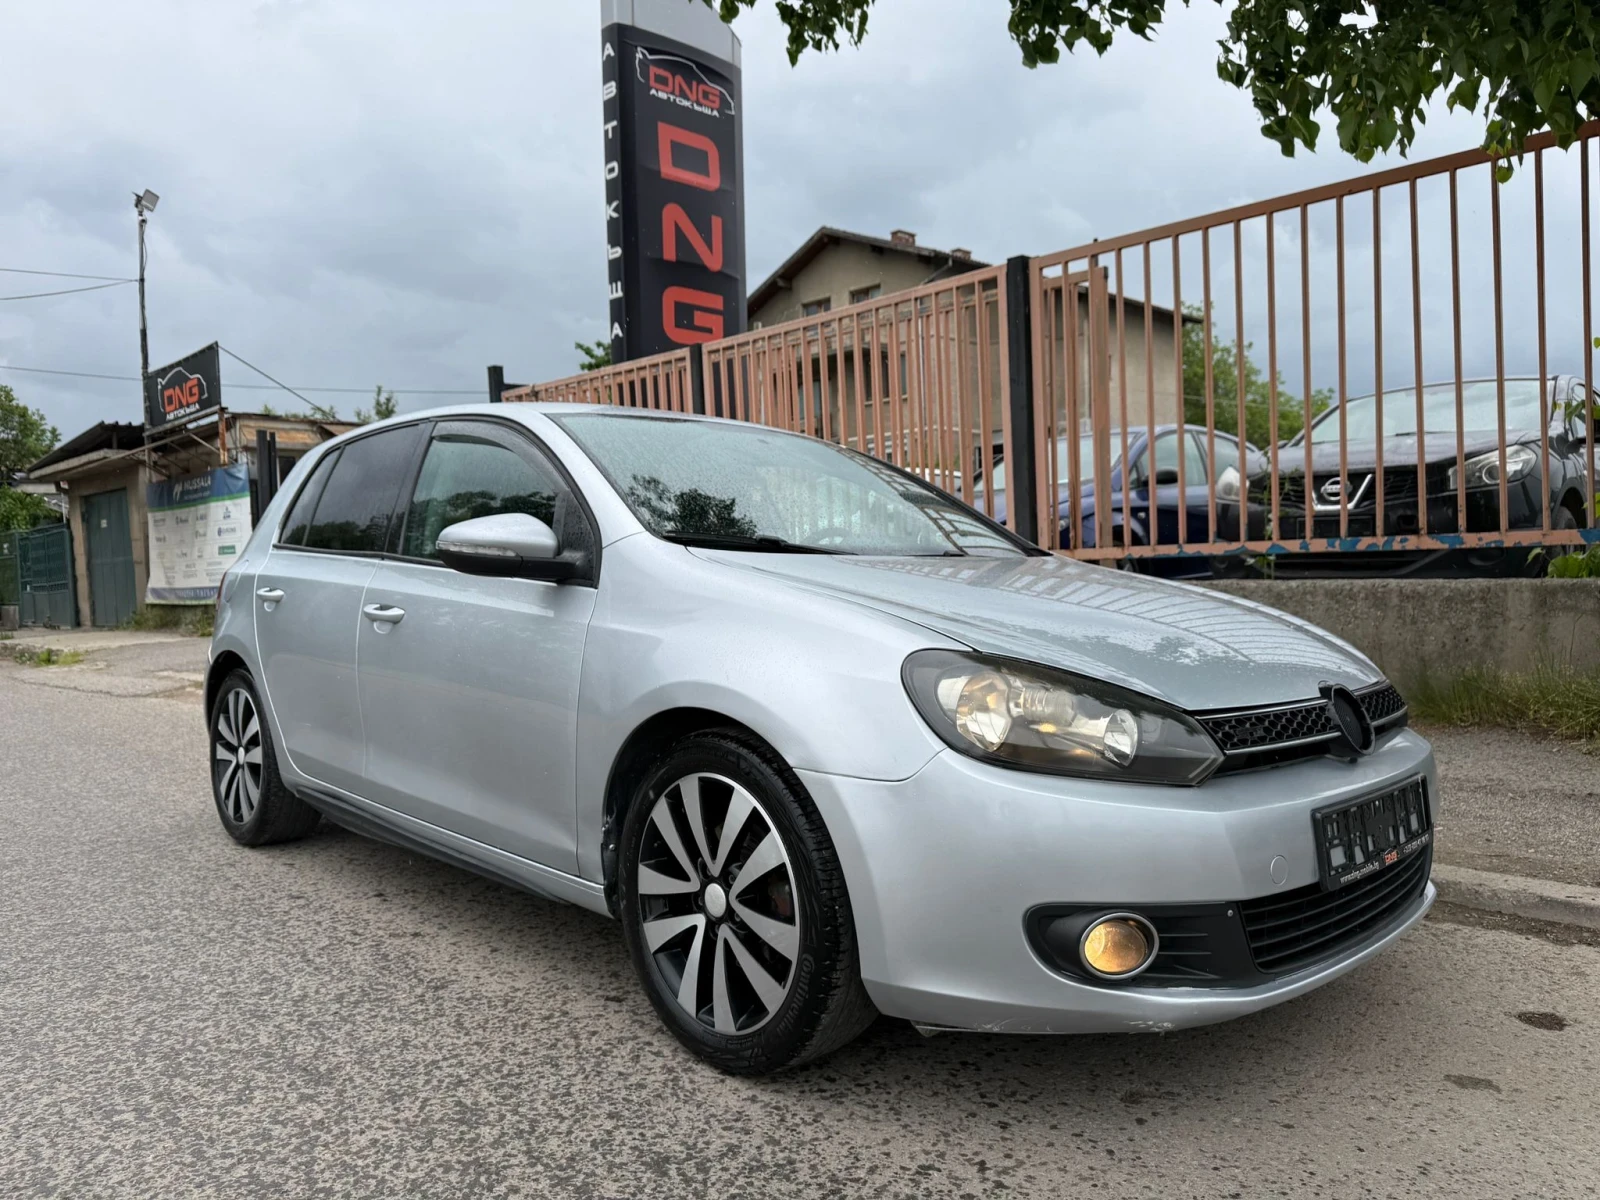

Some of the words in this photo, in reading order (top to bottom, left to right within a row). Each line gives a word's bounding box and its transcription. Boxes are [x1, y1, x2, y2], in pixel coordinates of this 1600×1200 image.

[649, 65, 721, 110] DNG
[657, 121, 724, 345] DNG
[163, 377, 200, 414] DNG
